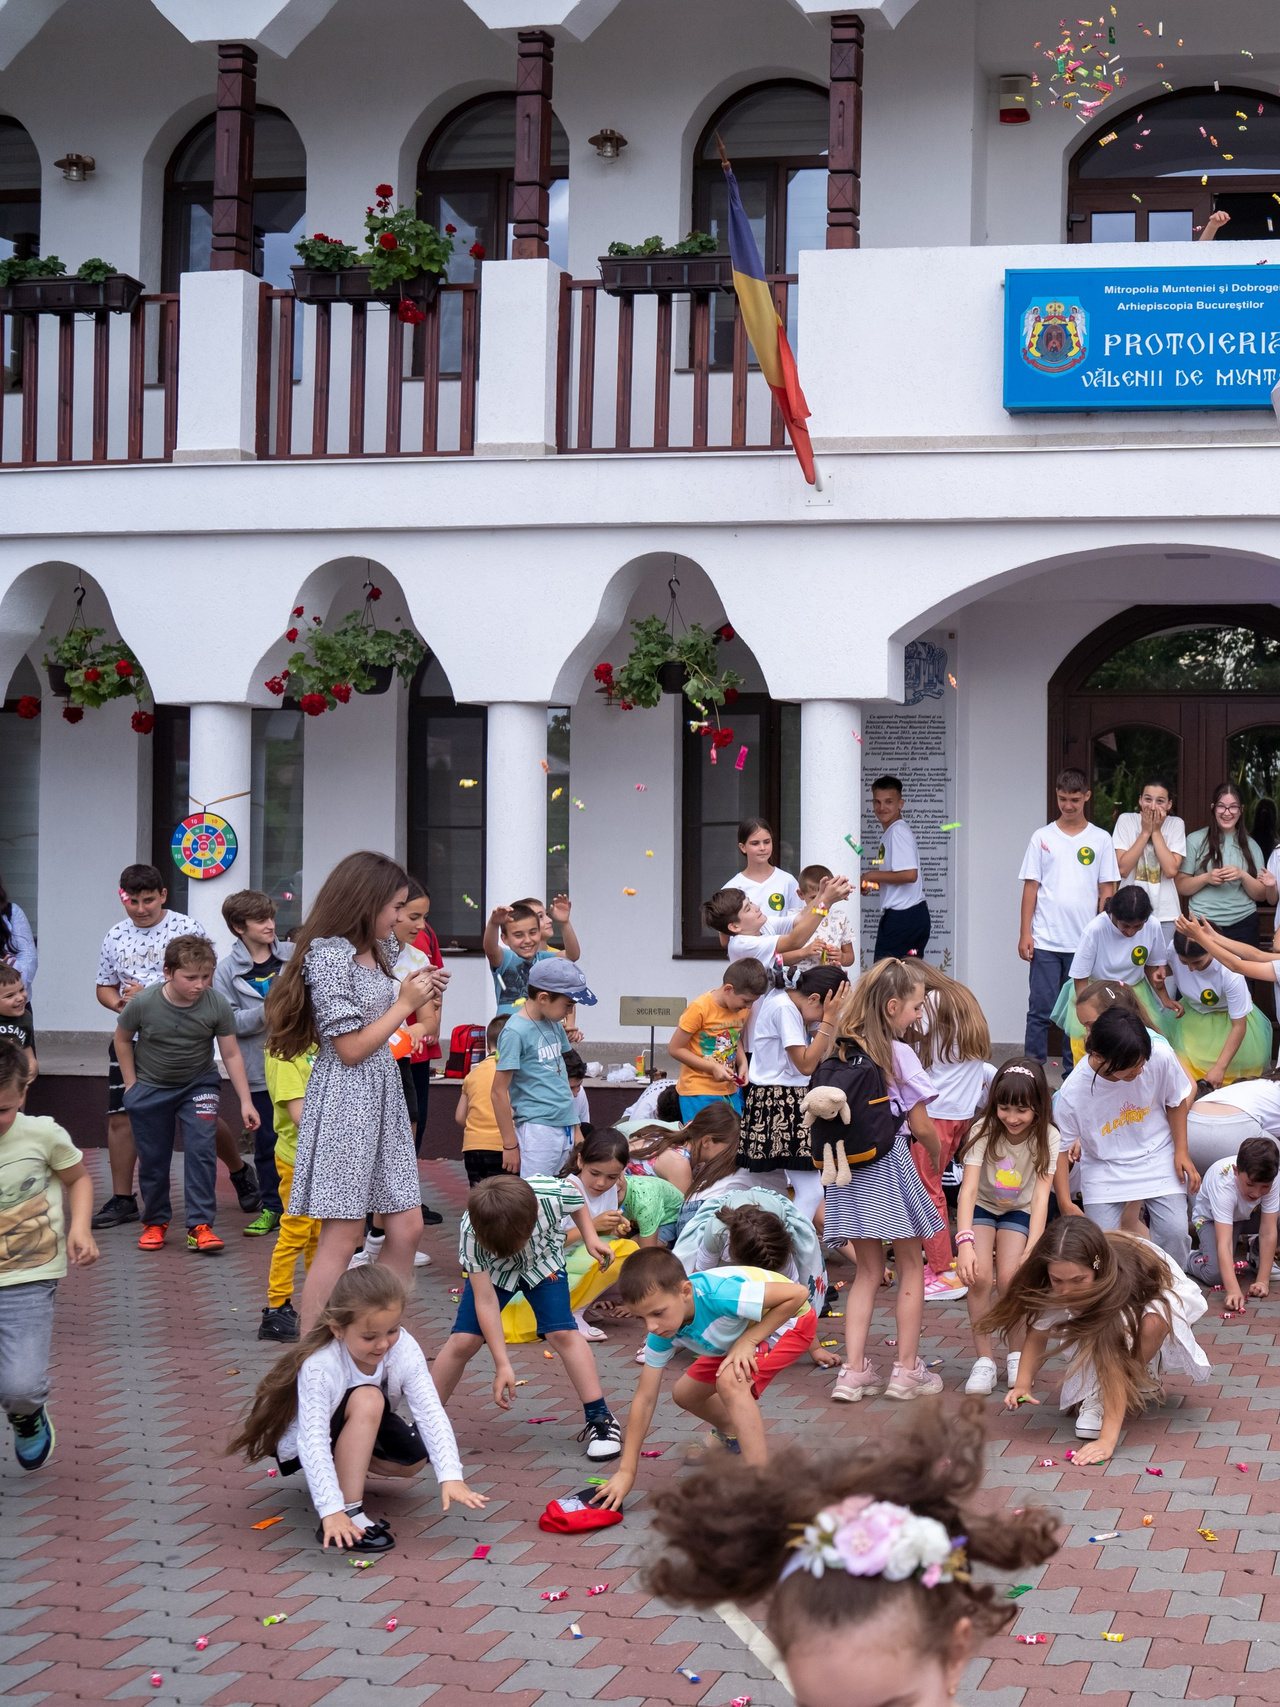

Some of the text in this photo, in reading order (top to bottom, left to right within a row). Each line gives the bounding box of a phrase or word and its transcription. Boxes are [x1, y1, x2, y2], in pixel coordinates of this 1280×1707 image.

[1104, 285, 1159, 295] Mitropolia
[1162, 284, 1216, 293] Munteniei
[1117, 302, 1194, 312] Arhiepiscopia
[1081, 367, 1163, 388] VĂLENII
[1175, 369, 1204, 387] DE
